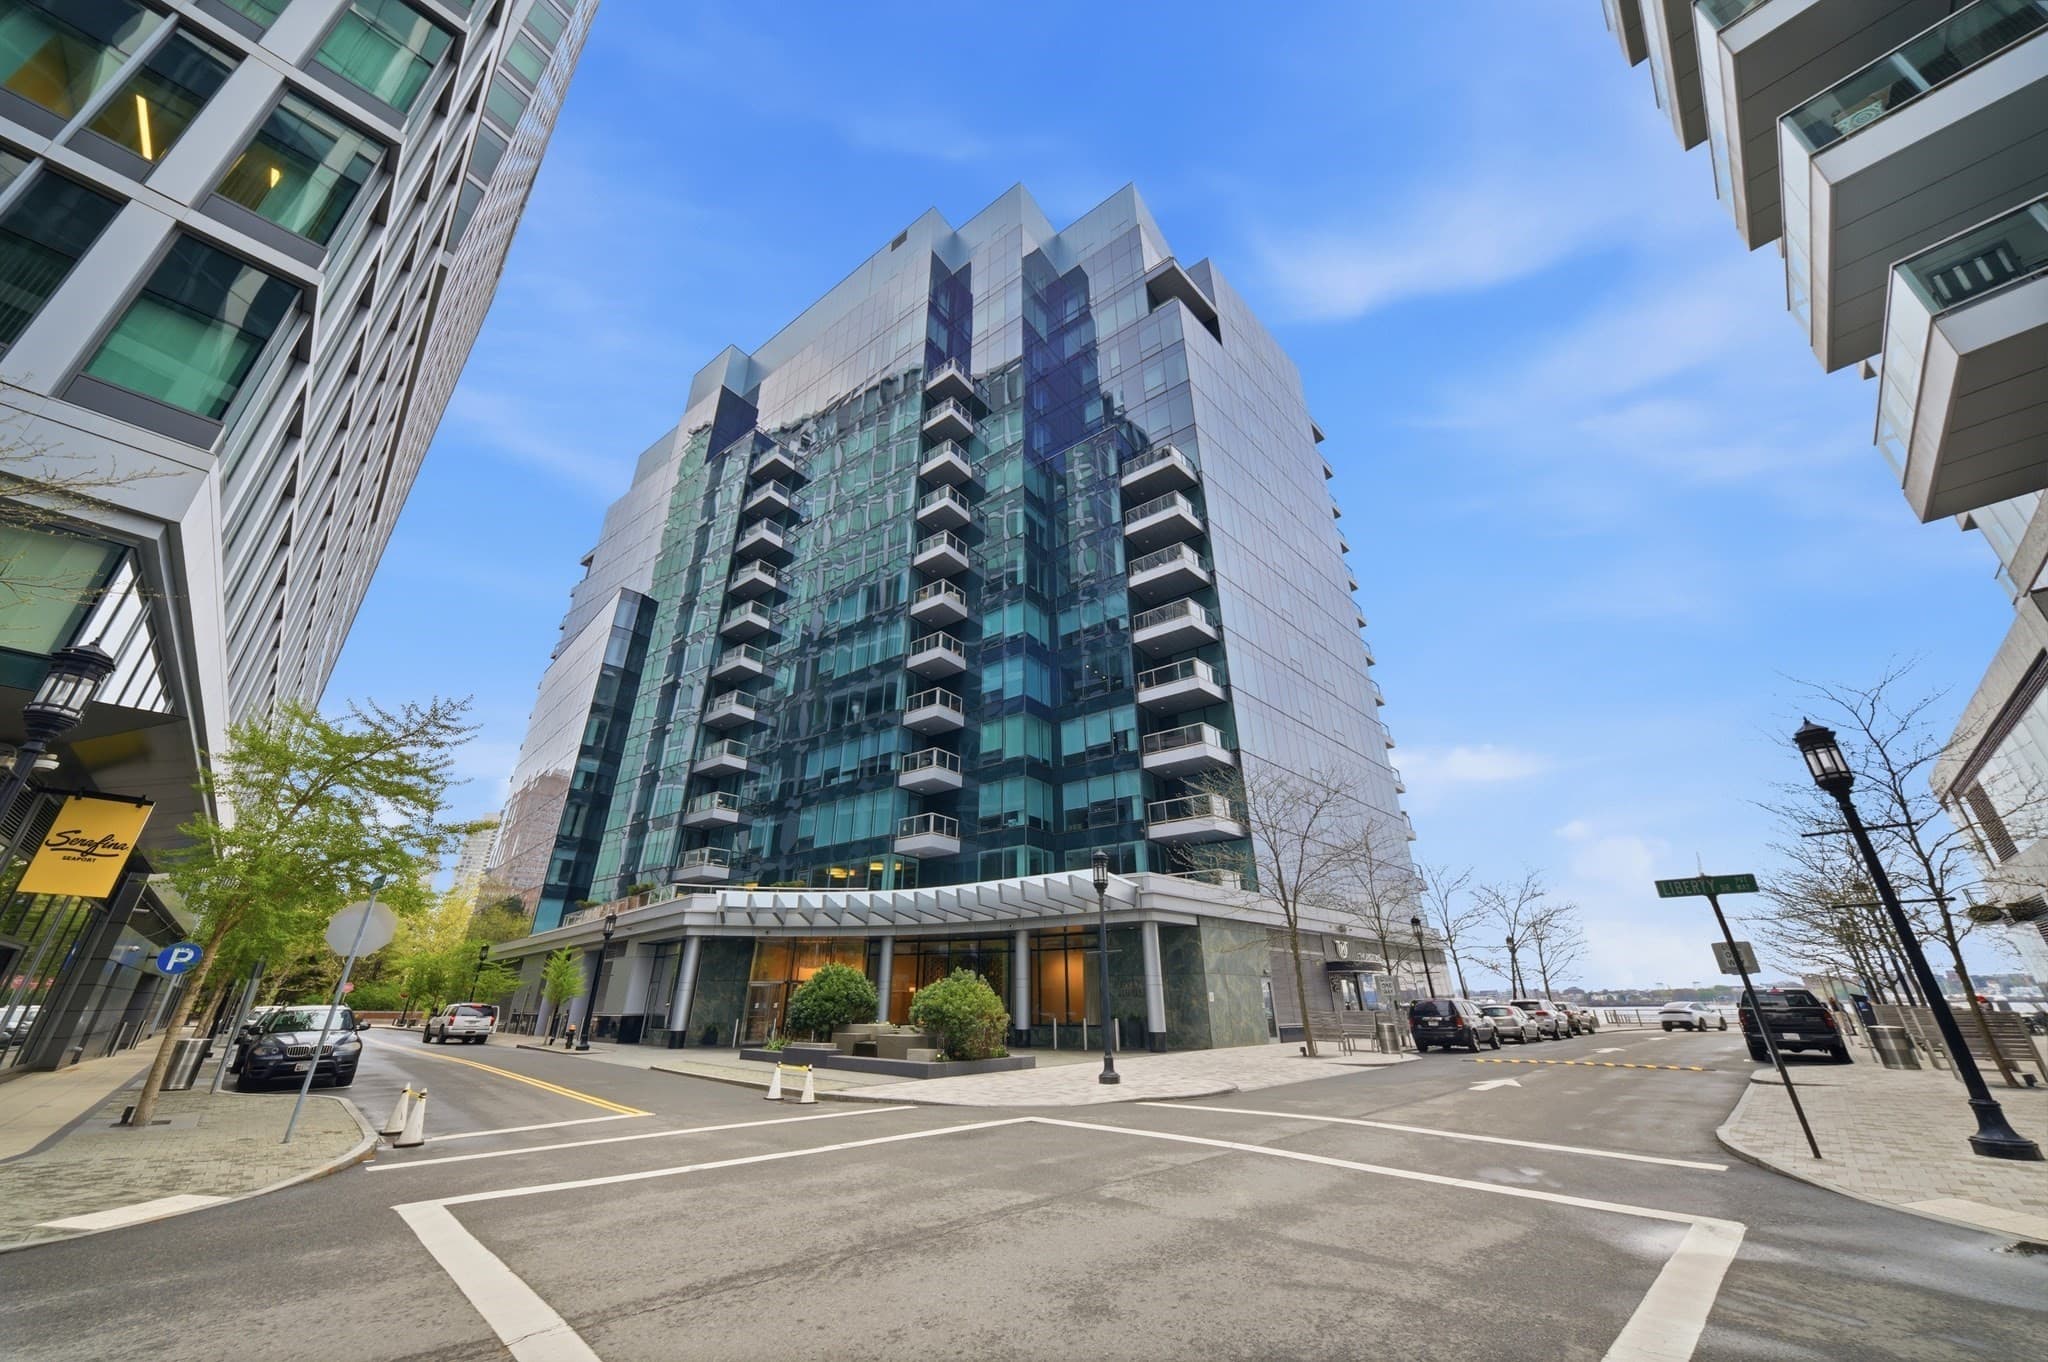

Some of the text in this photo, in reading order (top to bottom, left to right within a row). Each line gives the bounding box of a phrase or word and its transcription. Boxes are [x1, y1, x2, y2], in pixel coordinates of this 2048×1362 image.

[45, 830, 128, 857] Serafina
[62, 855, 97, 864] SEAPORT
[1661, 879, 1714, 896] LIBERTY
[166, 947, 194, 971] P
